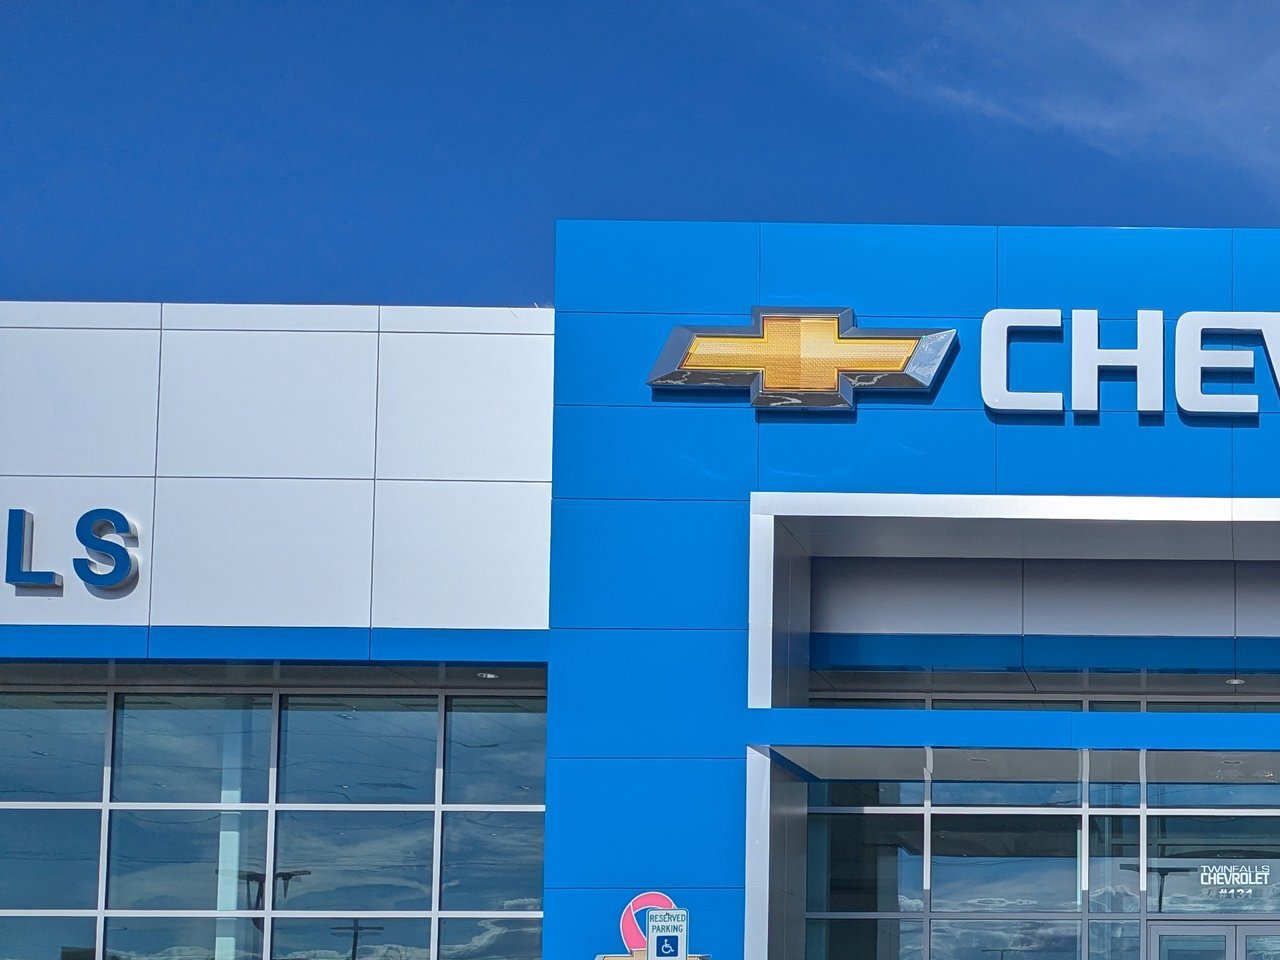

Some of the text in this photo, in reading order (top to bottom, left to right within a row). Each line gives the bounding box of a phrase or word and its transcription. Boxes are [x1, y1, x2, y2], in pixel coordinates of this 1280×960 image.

[1200, 873, 1270, 885] CHEVROLET
[649, 914, 686, 923] RESERVED
[651, 925, 684, 933] PARKING
